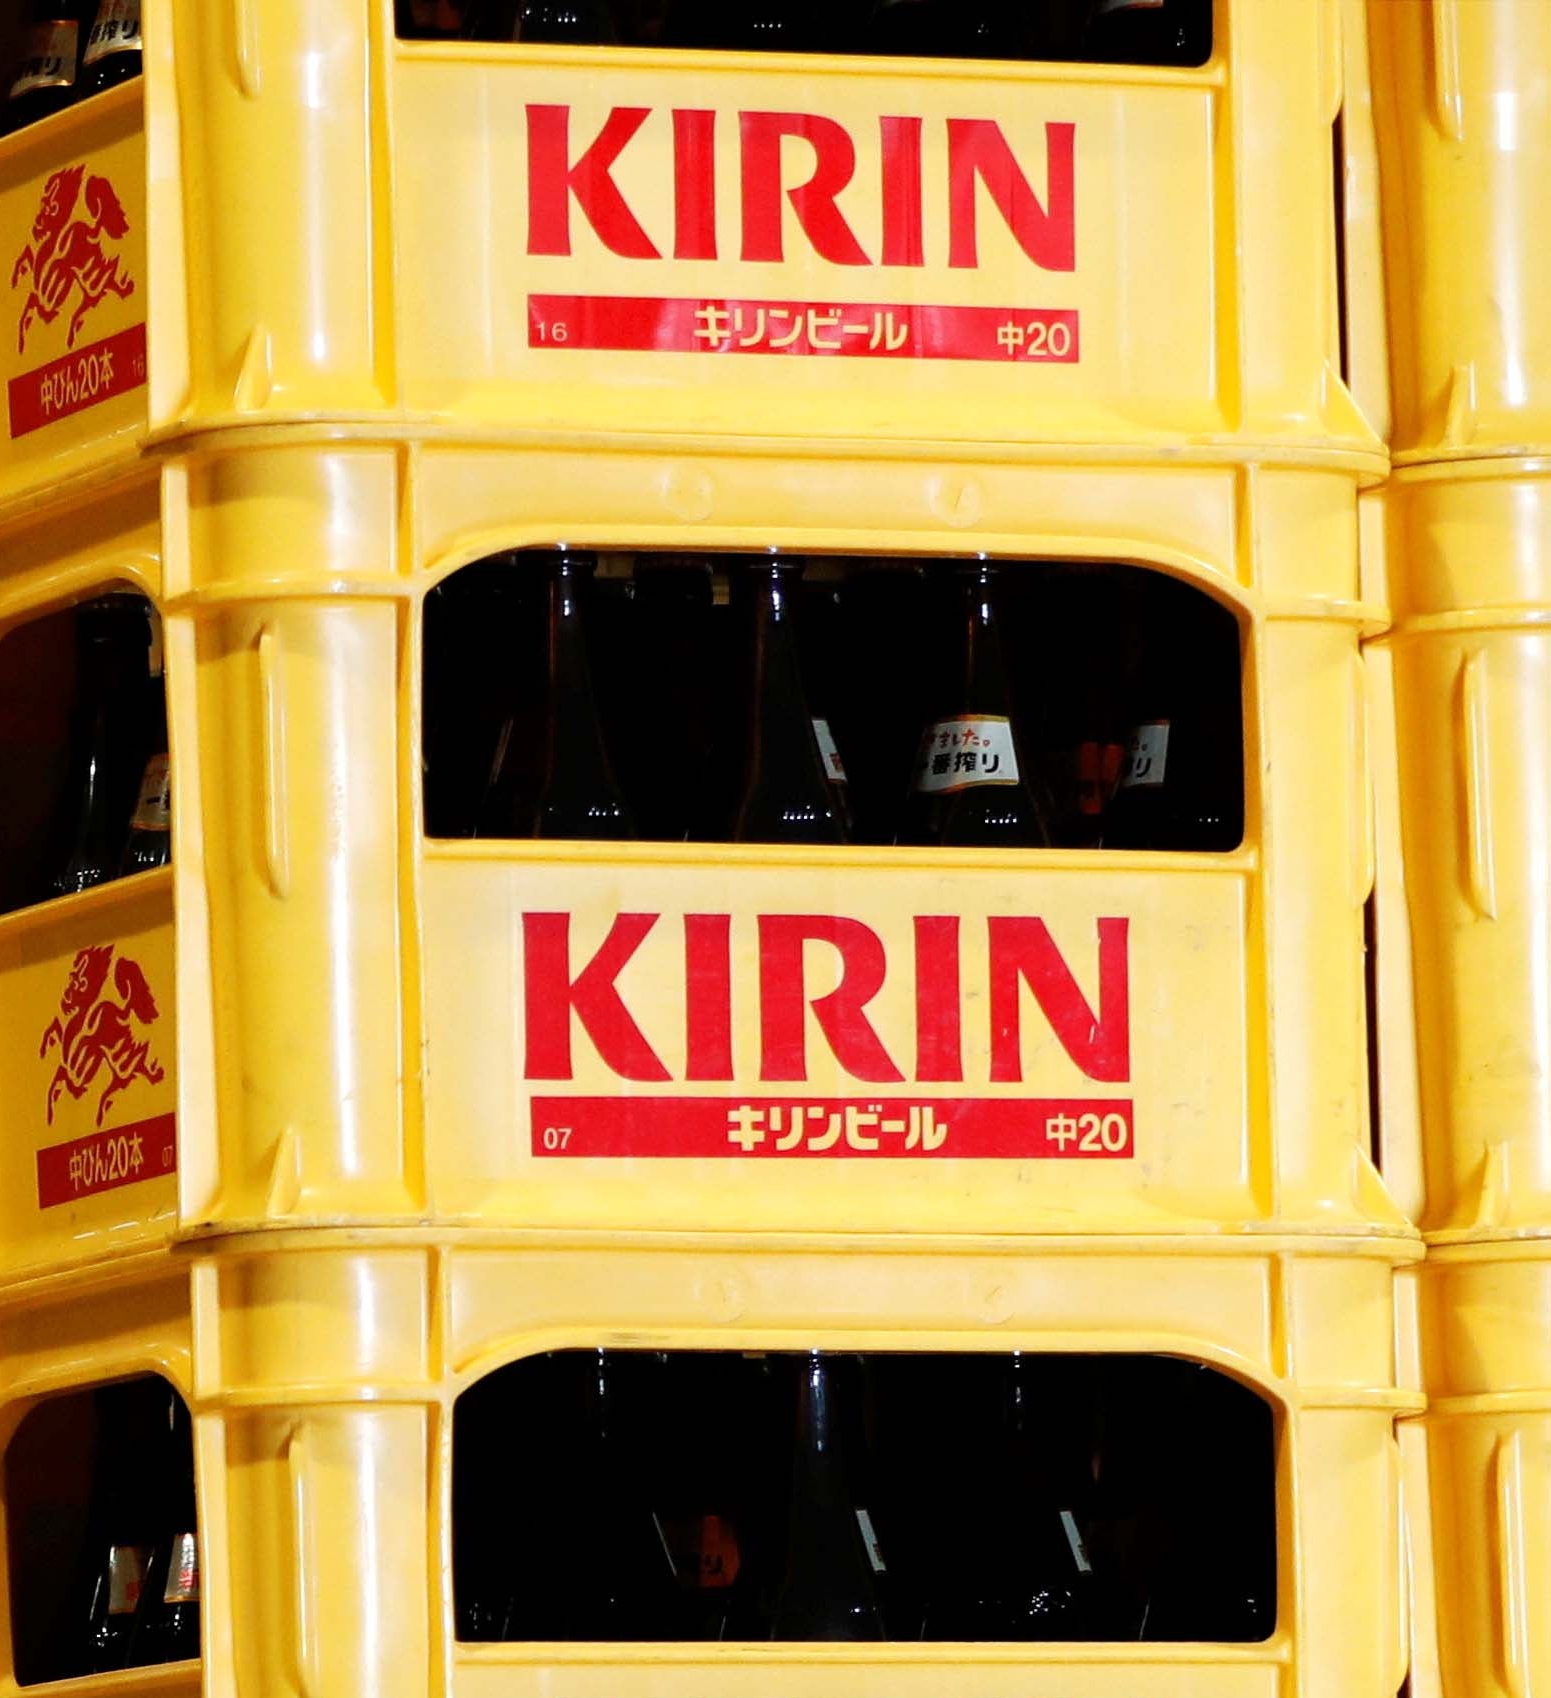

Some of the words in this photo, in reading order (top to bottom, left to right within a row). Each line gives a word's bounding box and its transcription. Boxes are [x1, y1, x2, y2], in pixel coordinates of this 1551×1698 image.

[526, 104, 1076, 272] KIRIN
[537, 321, 568, 341] 16
[693, 301, 909, 354] キリンビール
[996, 322, 1072, 357] 中20
[40, 347, 115, 416] 中びん20本
[523, 911, 1130, 1083] KIRIN
[543, 1127, 572, 1150] 07
[727, 1104, 948, 1152] キリンビール
[1045, 1112, 1128, 1152] 中20
[69, 1131, 144, 1192] 中びん20本
